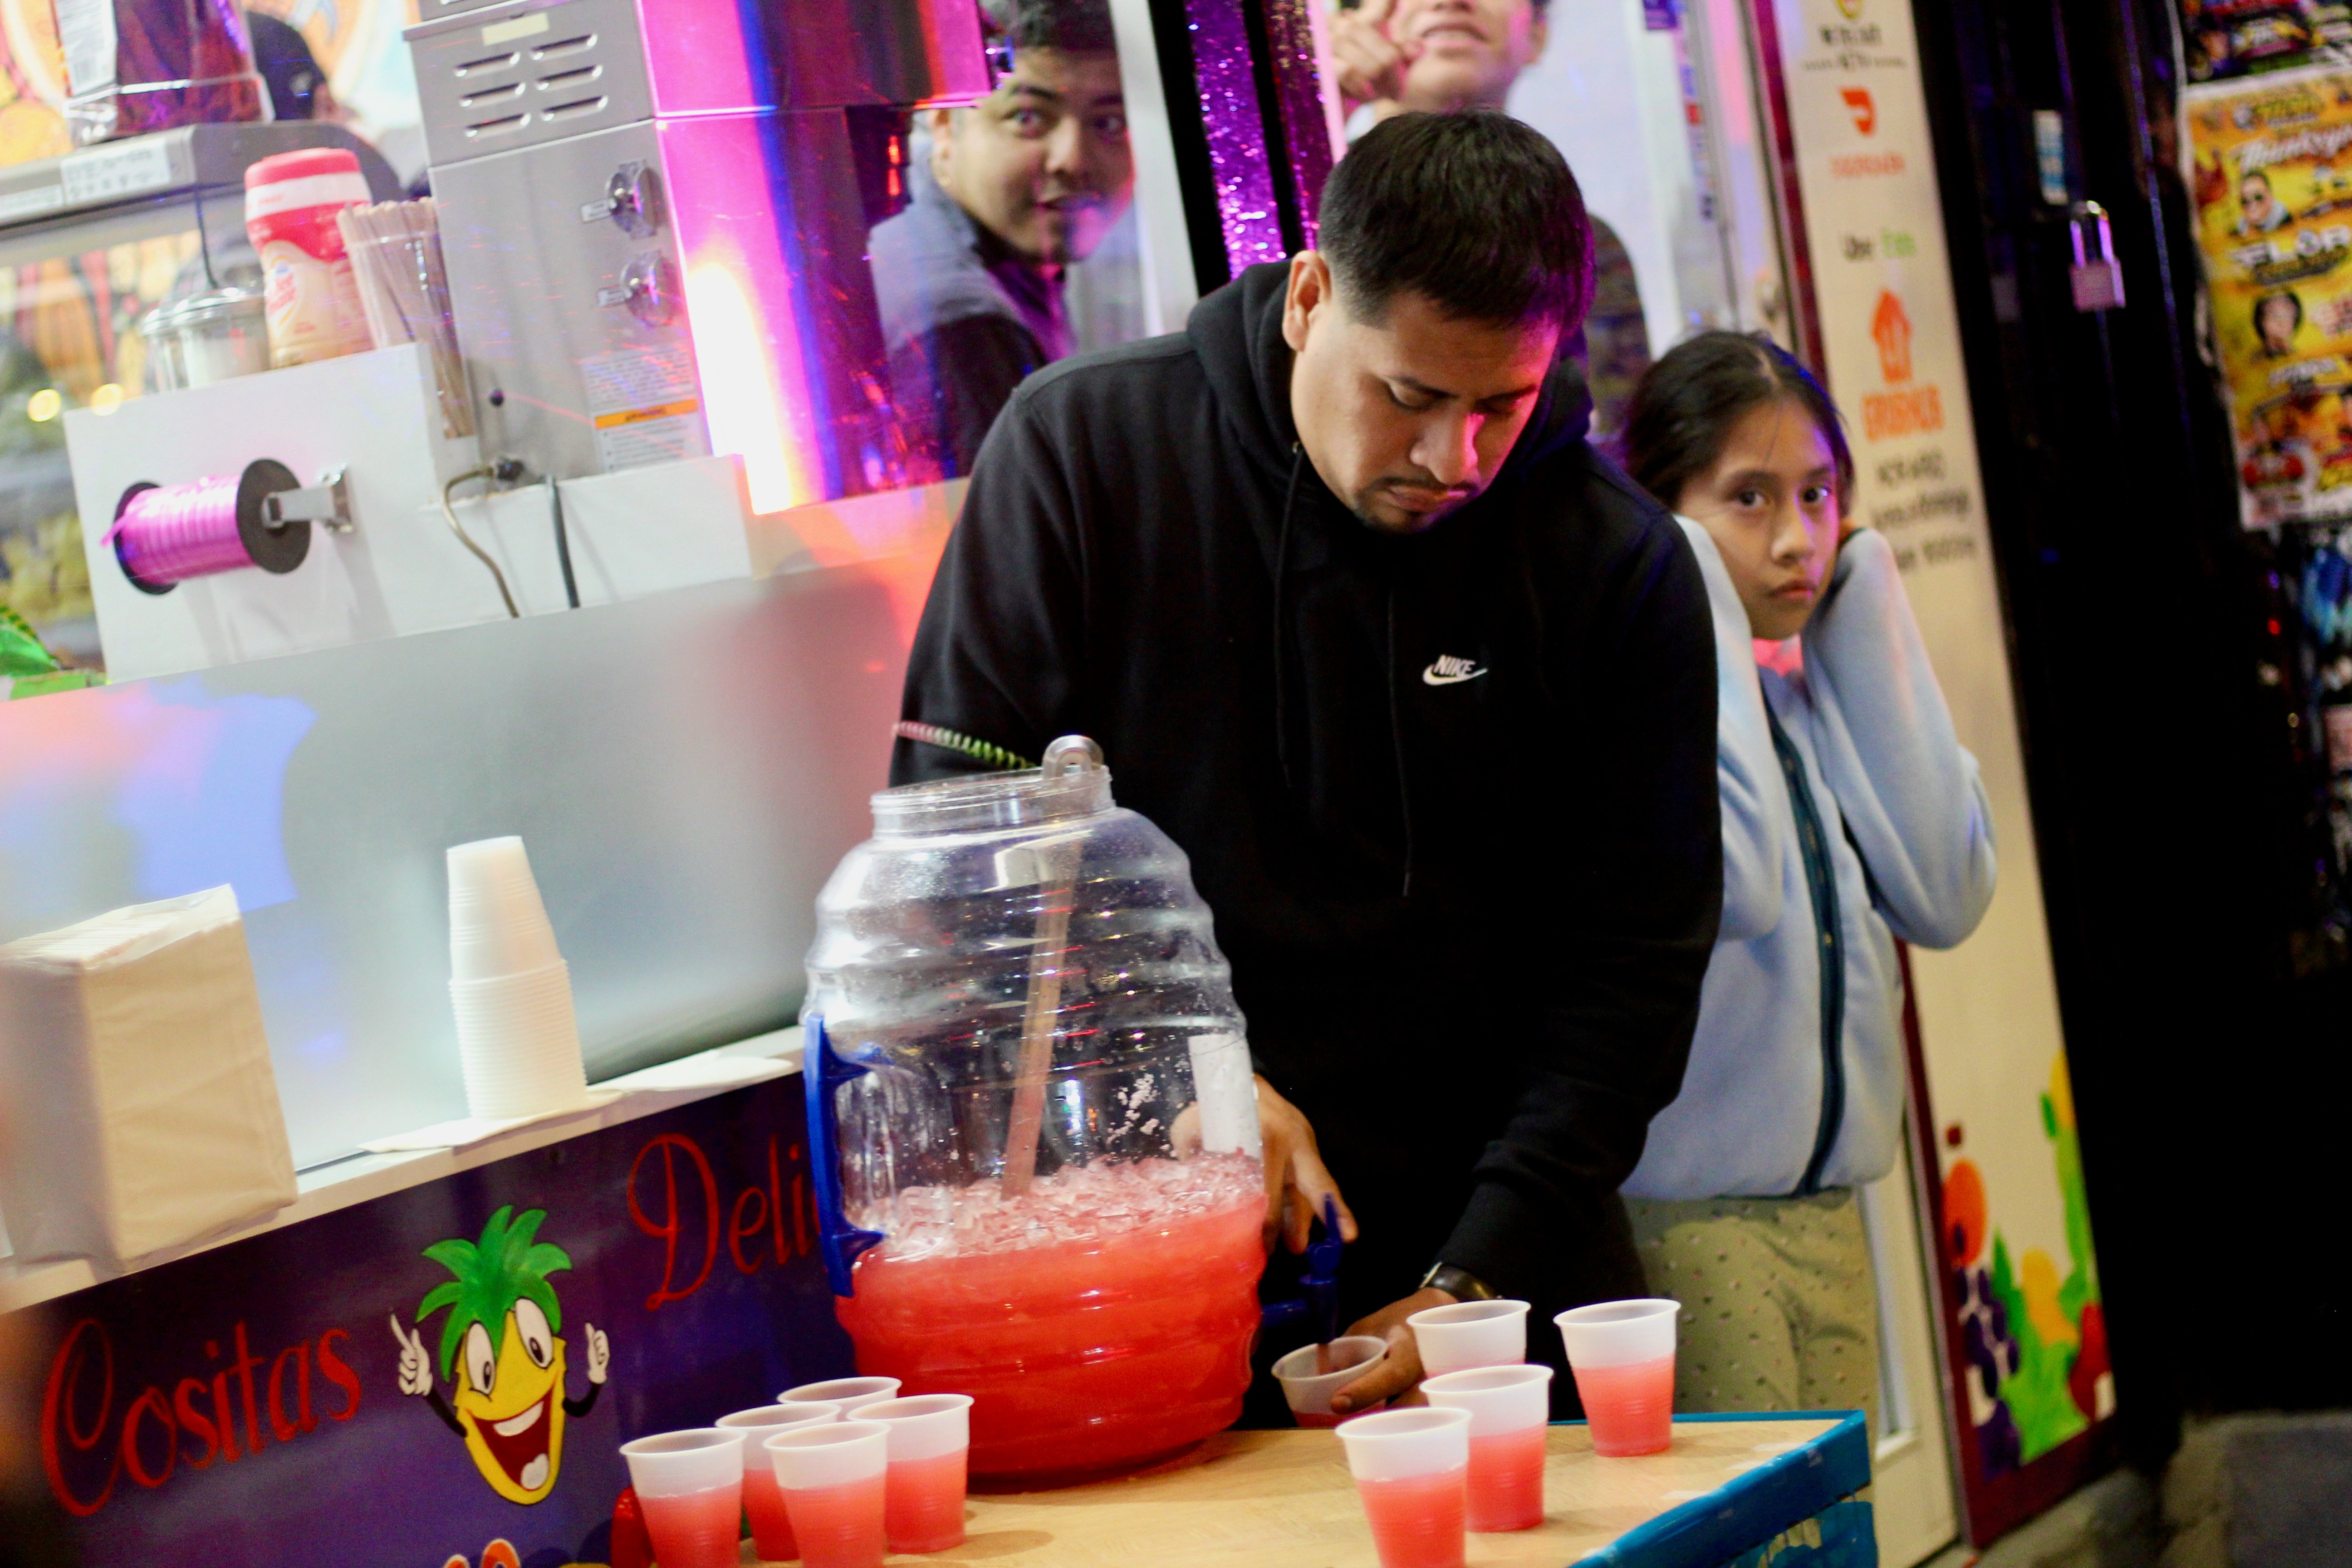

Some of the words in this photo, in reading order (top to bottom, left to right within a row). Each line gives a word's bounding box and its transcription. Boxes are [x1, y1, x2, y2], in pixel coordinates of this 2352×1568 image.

[1433, 654, 1476, 676] NIKE
[41, 1318, 362, 1516] Cositas
[627, 1133, 822, 1311] Deli
